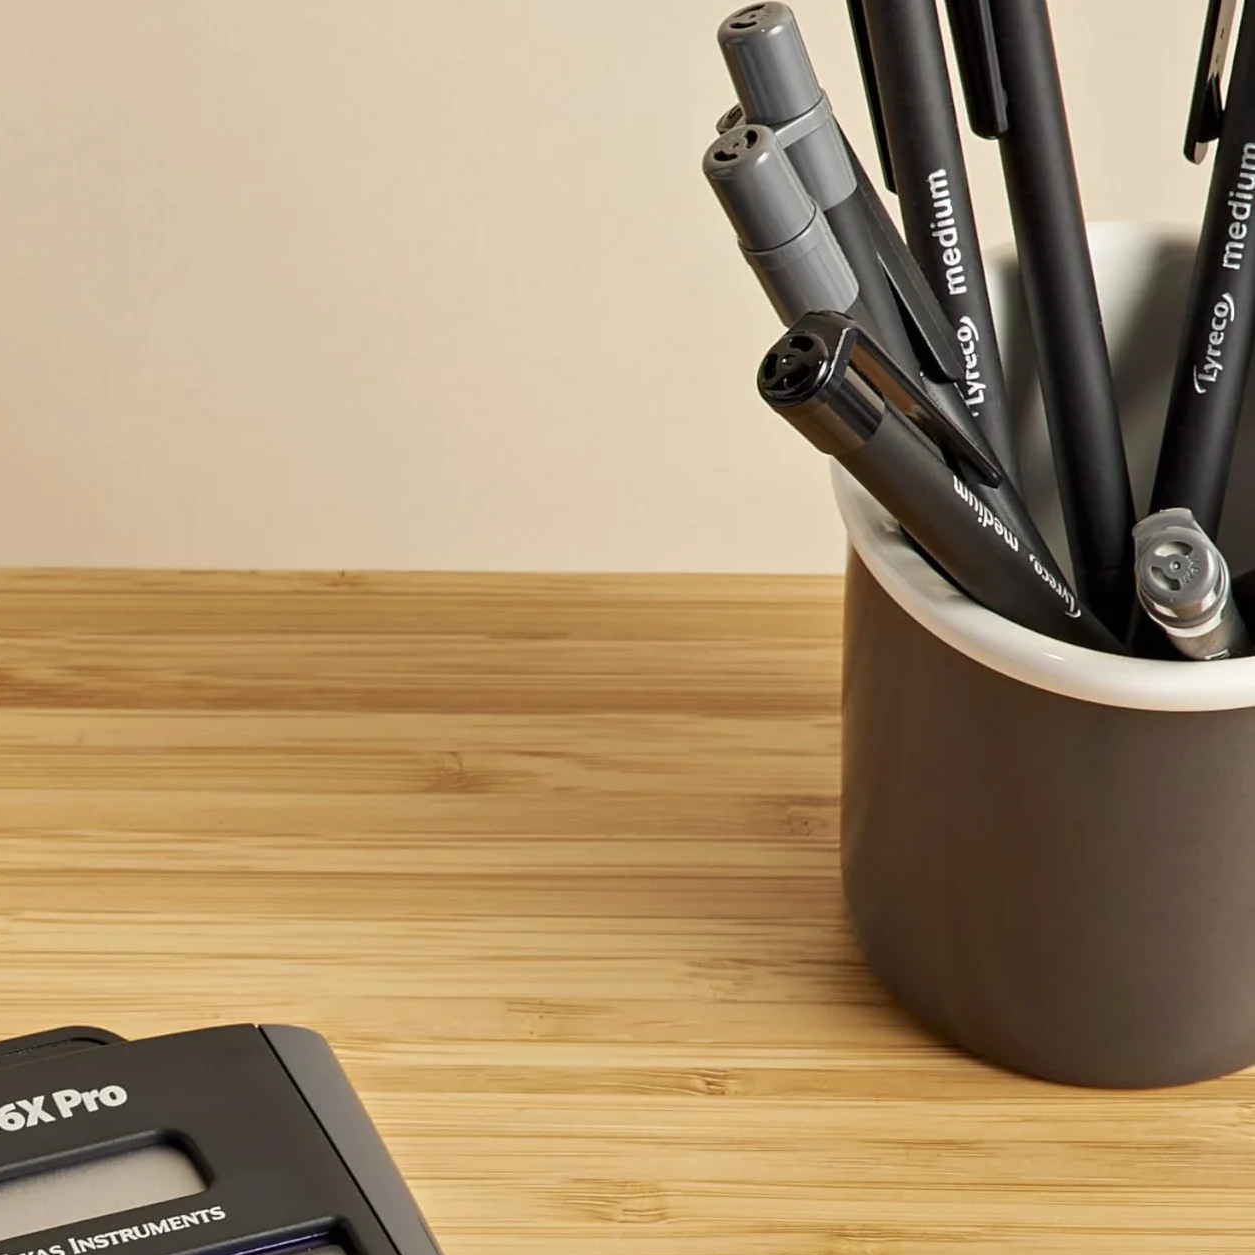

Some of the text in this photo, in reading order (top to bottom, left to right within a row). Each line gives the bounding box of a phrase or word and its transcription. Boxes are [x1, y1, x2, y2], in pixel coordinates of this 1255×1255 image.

[928, 169, 967, 295] medium
[1193, 293, 1235, 394] Lyreco
[952, 474, 1081, 618] Lyreco medium
[52, 1085, 128, 1118] Pro
[67, 1206, 226, 1255] INSTRUMENTS
